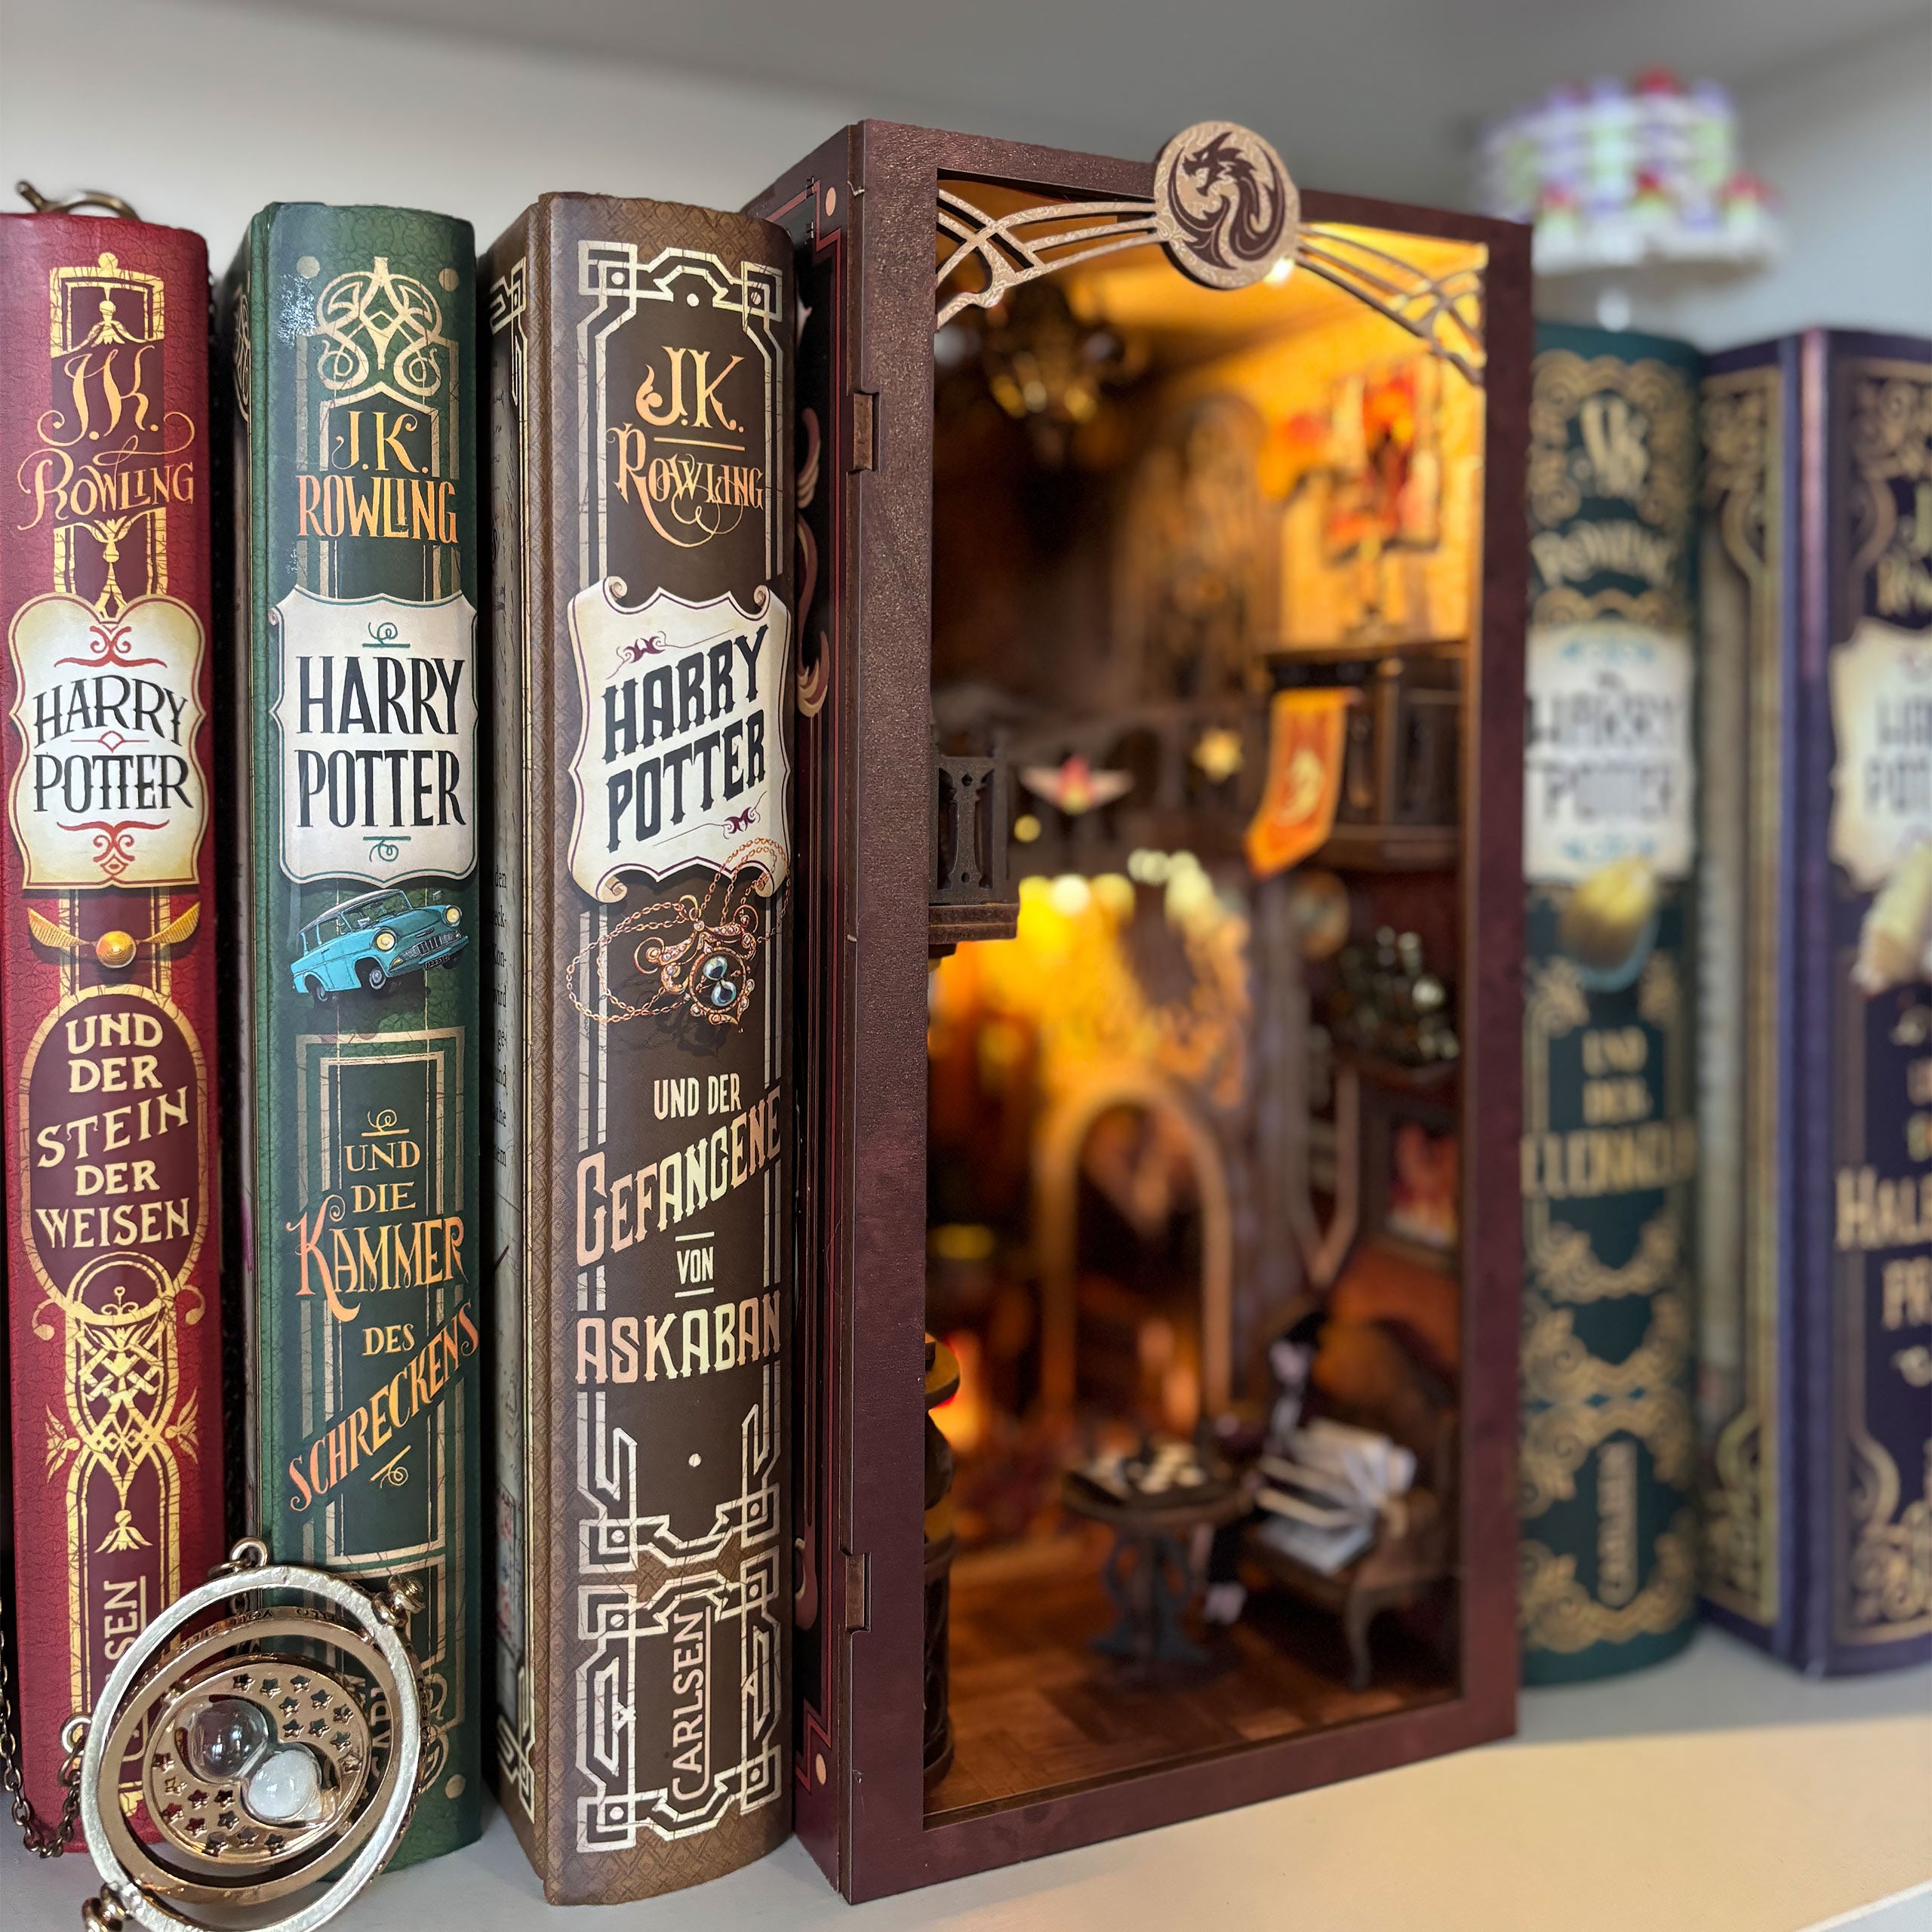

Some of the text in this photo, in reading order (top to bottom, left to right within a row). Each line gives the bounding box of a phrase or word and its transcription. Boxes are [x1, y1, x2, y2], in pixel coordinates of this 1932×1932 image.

[37, 346, 157, 446] J.K.
[635, 345, 746, 432] J.K.
[17, 419, 195, 530] ROWLING
[332, 411, 429, 474] J.K.
[298, 474, 459, 544] ROWLING
[606, 422, 764, 549] ROWLING
[33, 674, 189, 749] HARRY
[296, 655, 466, 736] HARRY
[601, 623, 769, 762] HARRY
[32, 754, 195, 813] POTTER
[294, 749, 467, 829] POTTER
[605, 707, 765, 854] POTTER
[65, 1012, 163, 1050] UND
[69, 1057, 163, 1093] DER
[653, 1072, 742, 1121] UND DER
[36, 1087, 190, 1168] STEIN
[343, 1140, 421, 1174] UND
[75, 1165, 161, 1196] DER
[352, 1181, 417, 1214] DIE
[574, 1090, 781, 1268] GEFANGENE
[35, 1198, 191, 1249] WEISEN
[285, 1195, 471, 1322] KAMMER
[676, 1246, 715, 1284] VON
[362, 1323, 416, 1357] DES
[574, 1290, 781, 1385] ASKABAN
[288, 1300, 480, 1512] SCHRECKENS
[672, 1609, 708, 1801] CARLSEN
